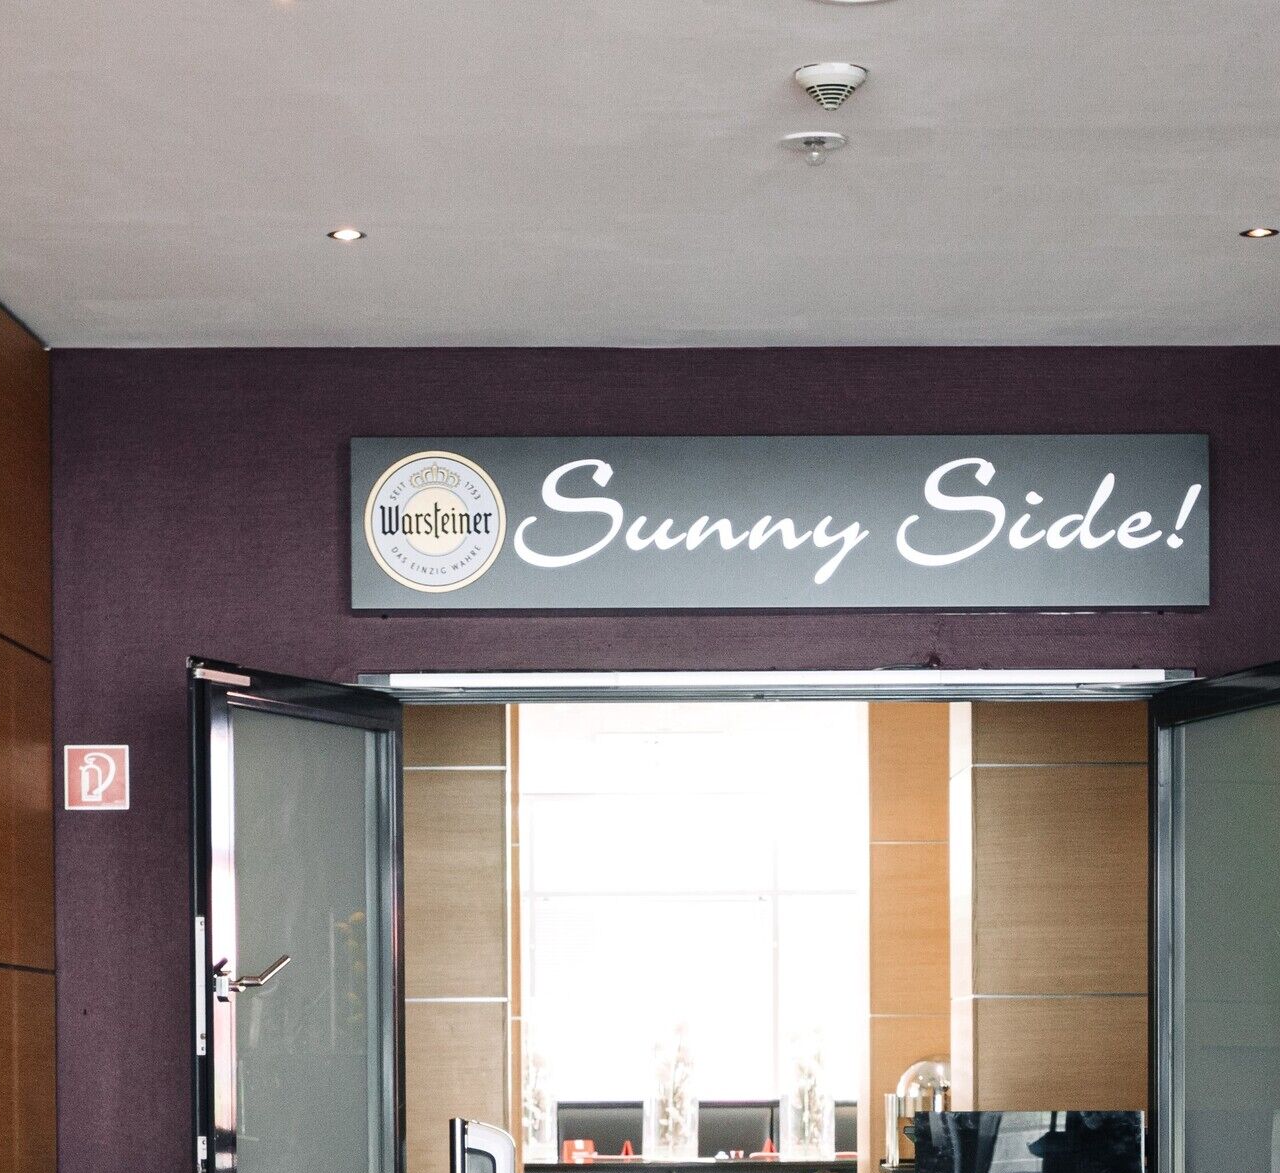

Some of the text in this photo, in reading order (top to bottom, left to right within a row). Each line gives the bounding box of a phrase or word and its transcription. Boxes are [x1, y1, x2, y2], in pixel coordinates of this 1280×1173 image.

[389, 481, 482, 501] SEIT 1753
[379, 502, 493, 539] Warsteiner
[513, 457, 1202, 586] Sunny Side!
[391, 545, 481, 575] DAS EINZIG WAHRE
